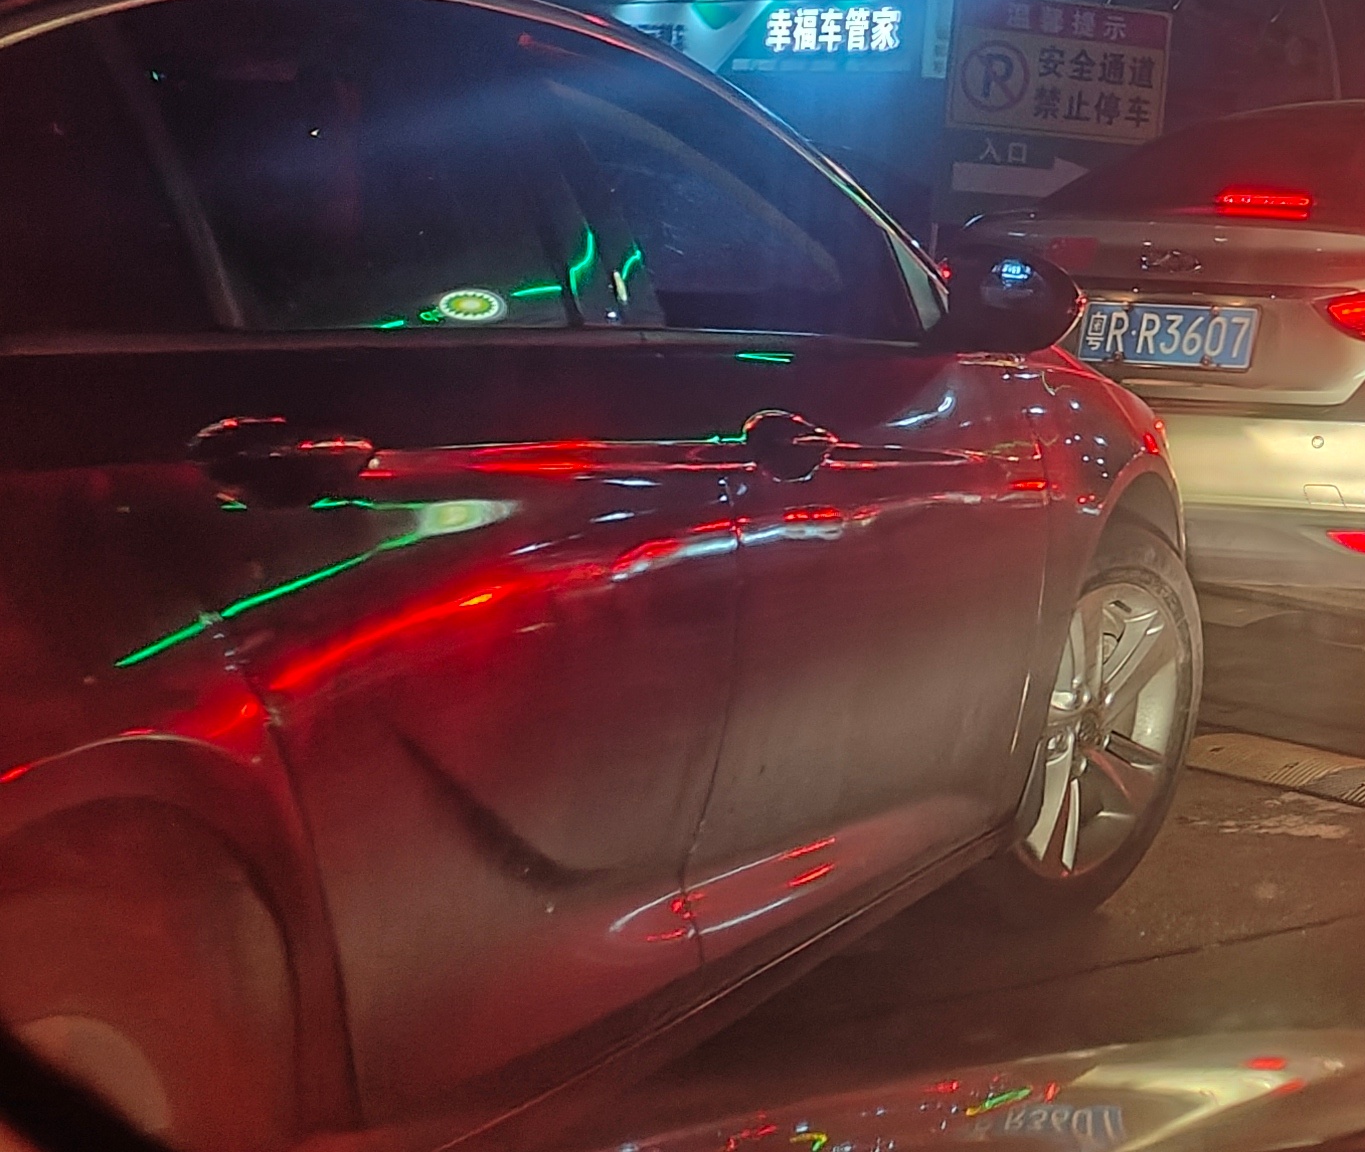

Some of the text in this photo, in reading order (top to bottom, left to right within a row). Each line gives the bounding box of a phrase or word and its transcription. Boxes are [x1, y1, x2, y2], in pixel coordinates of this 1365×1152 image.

[764, 5, 901, 53] 幸福车管家
[1006, 2, 1128, 42] 温馨提示
[1037, 45, 1156, 89] 安全通道
[1032, 85, 1151, 128] 禁止停车
[980, 140, 1028, 165] 入口
[1086, 311, 1251, 359] 粤R·R3607
